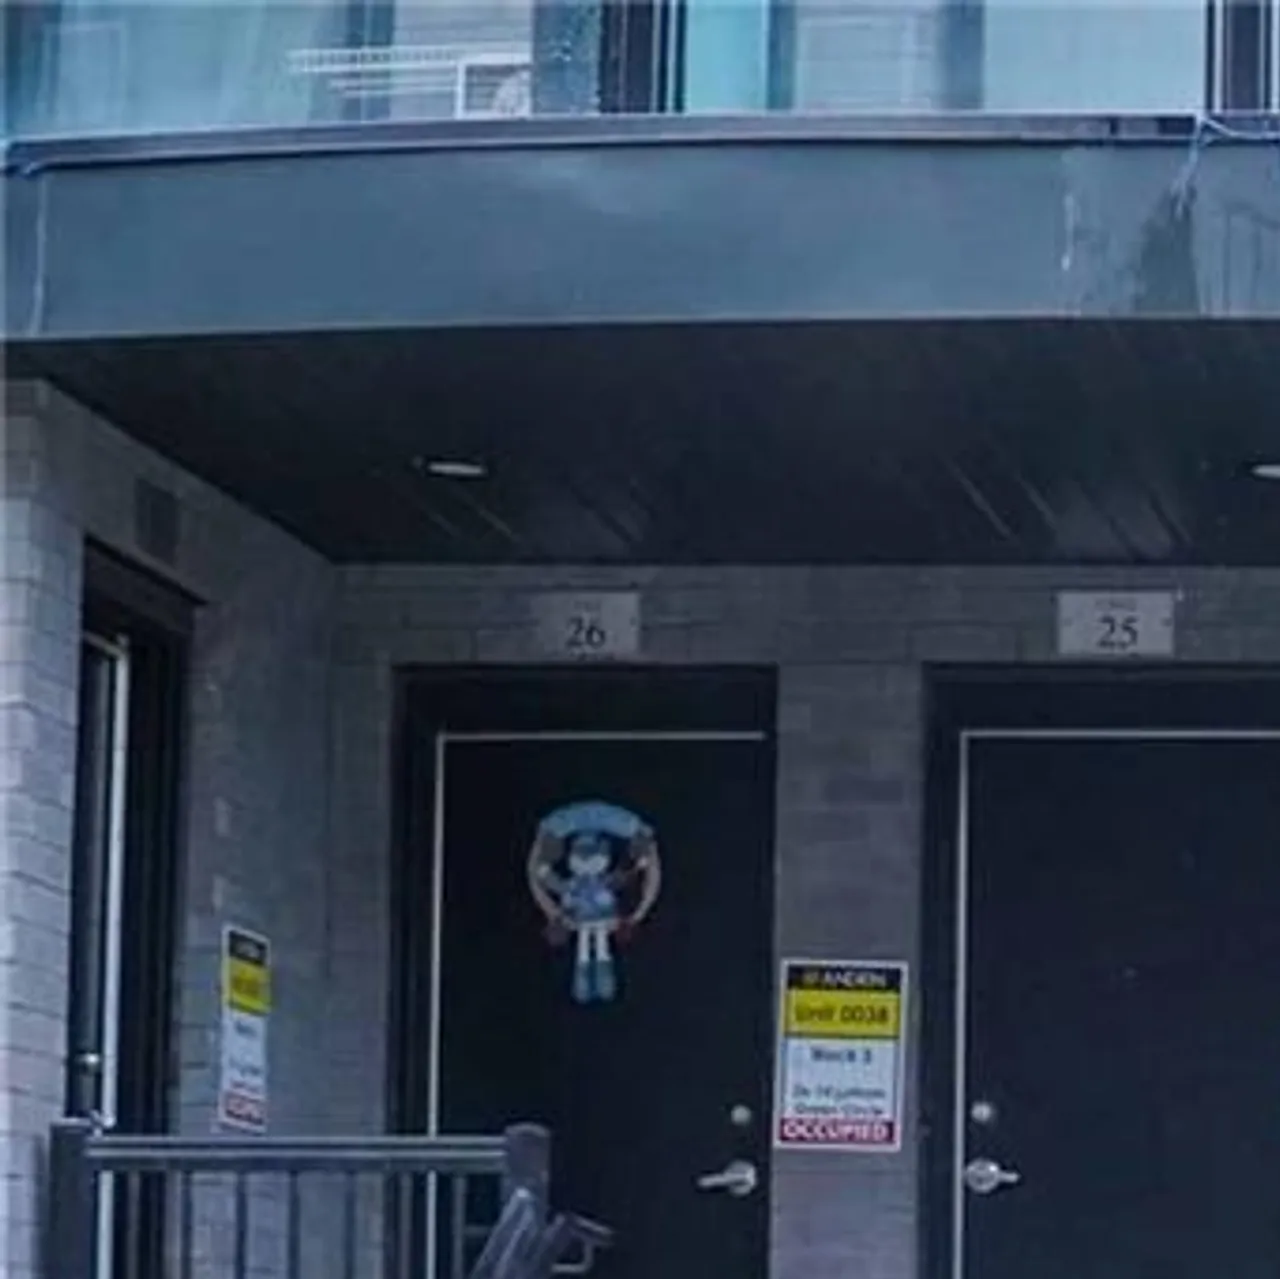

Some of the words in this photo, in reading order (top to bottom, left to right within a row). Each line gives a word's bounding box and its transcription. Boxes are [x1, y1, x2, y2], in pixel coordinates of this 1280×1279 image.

[565, 617, 606, 649] 26
[1097, 615, 1138, 648] 25
[795, 1004, 834, 1022] Unit
[782, 1123, 889, 1140] OCCUPIED
